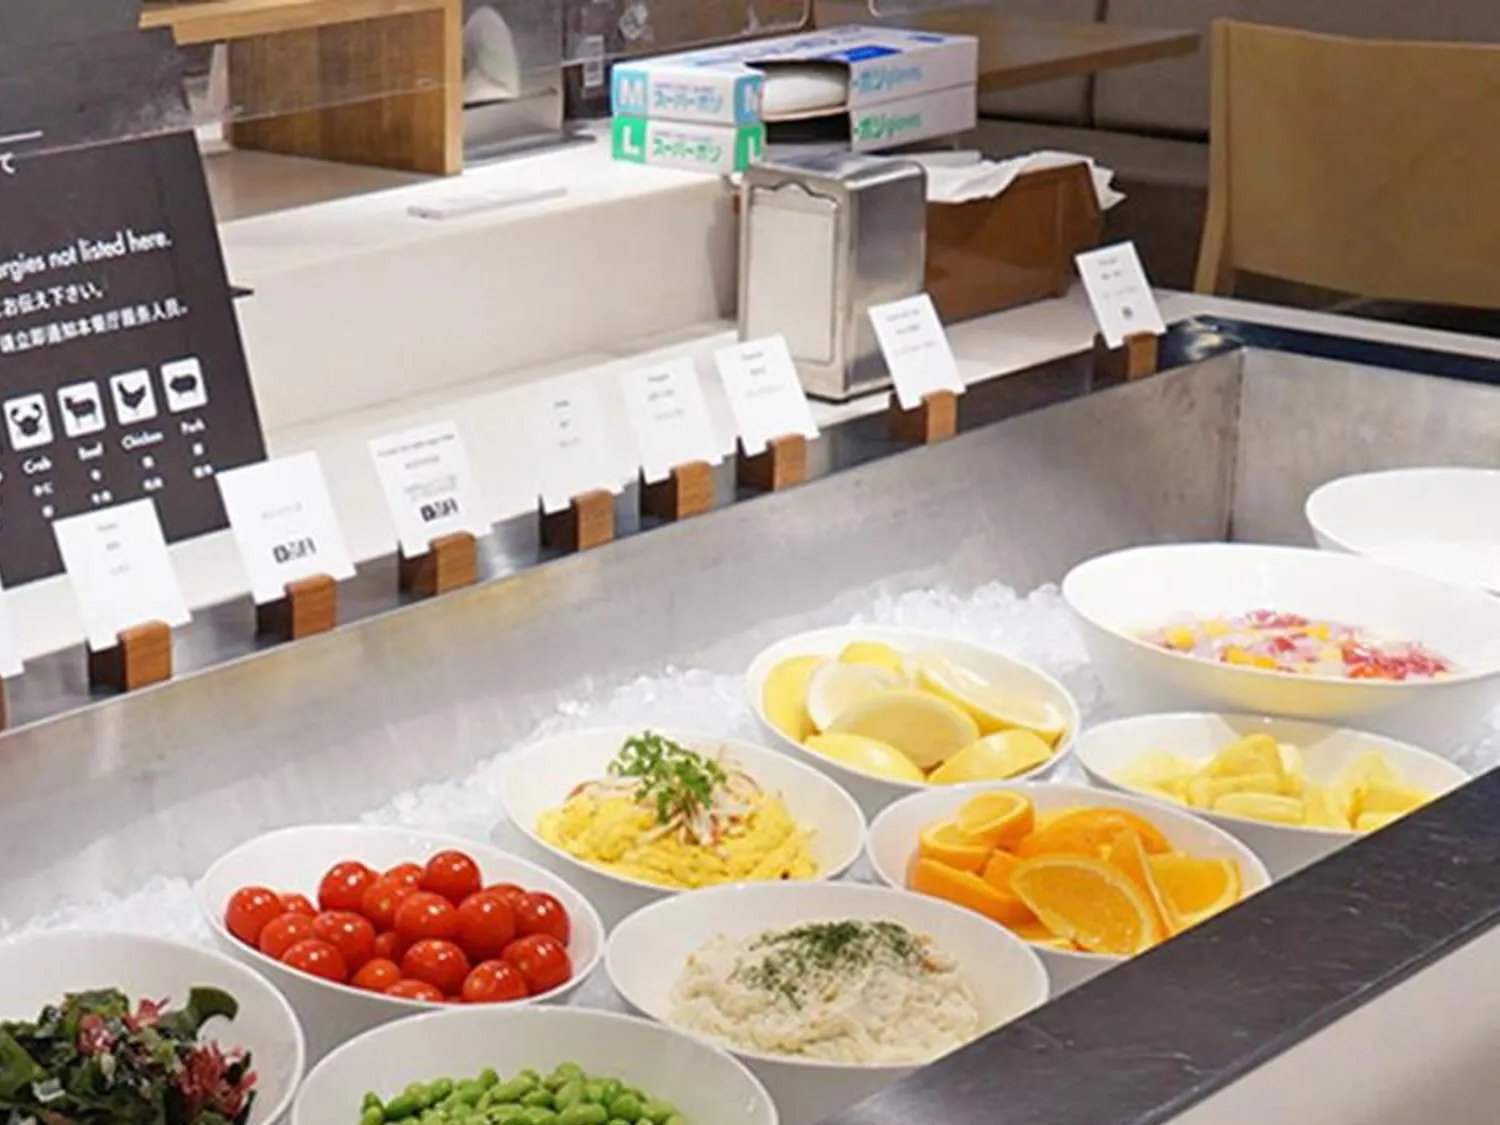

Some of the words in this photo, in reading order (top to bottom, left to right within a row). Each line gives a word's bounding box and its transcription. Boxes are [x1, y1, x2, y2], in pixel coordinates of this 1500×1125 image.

[619, 77, 643, 109] M
[622, 126, 640, 155] L
[49, 246, 77, 269] not
[77, 231, 126, 262] listed
[126, 228, 173, 253] here.
[120, 431, 164, 451] Chicken
[22, 456, 52, 474] Crab
